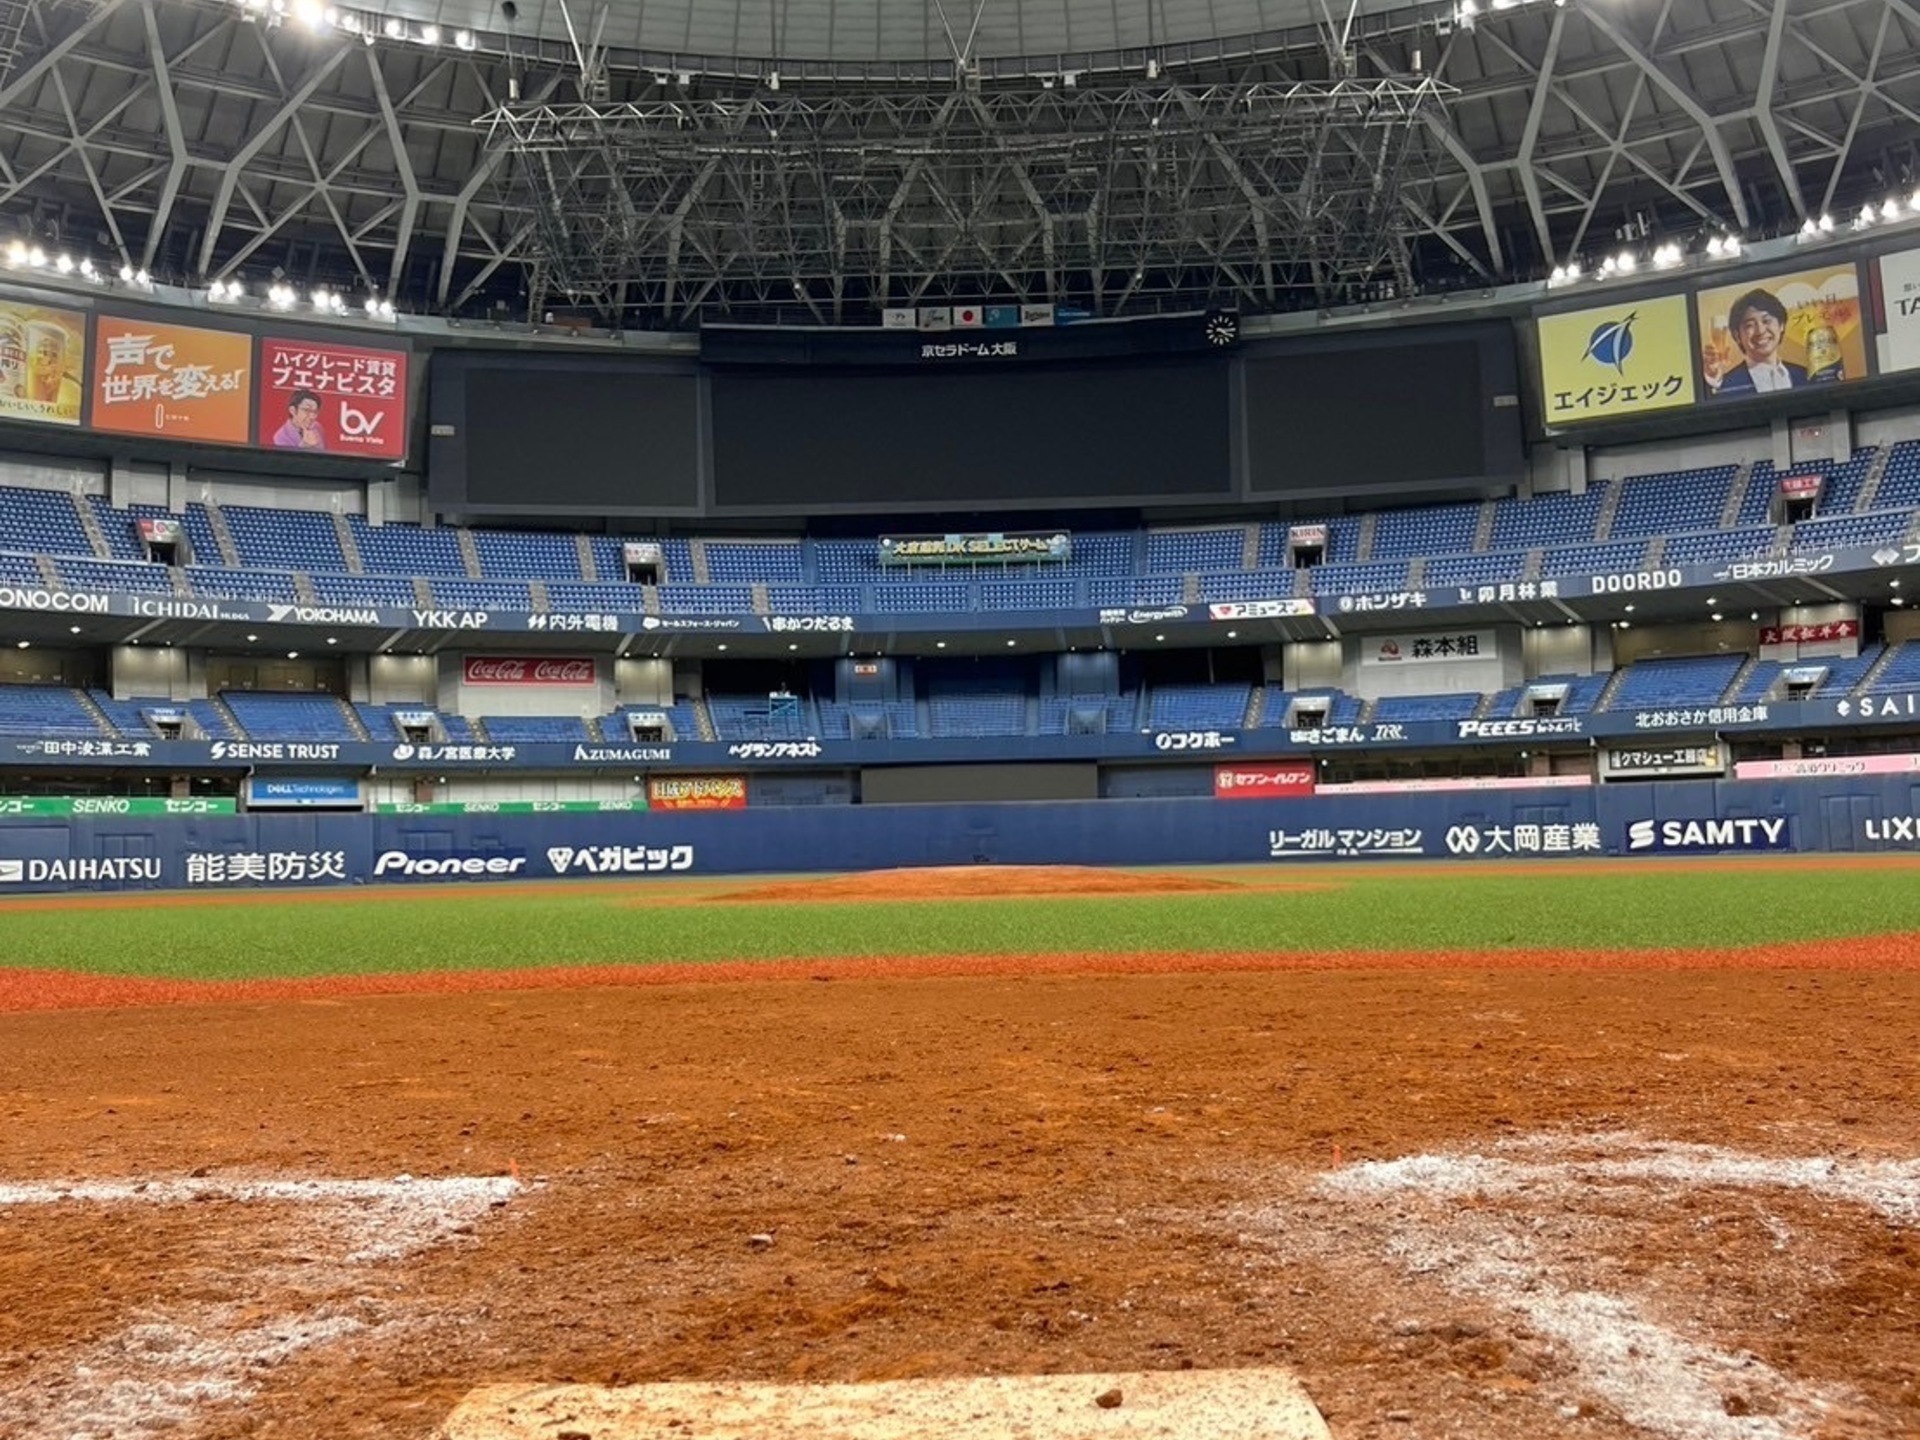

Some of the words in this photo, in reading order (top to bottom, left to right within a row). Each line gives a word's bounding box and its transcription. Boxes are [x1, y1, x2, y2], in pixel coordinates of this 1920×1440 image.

[105, 333, 175, 374] 声で
[921, 344, 989, 358] 京セラドーム
[273, 352, 397, 376] ハイグレード賃貸
[272, 366, 396, 396] ブエナビスタ
[1554, 375, 1683, 410] エイジェック
[1732, 554, 1834, 580] 日本カルミック
[1592, 569, 1682, 594] DOORDO
[294, 606, 380, 623] YOKOHAMA
[413, 610, 457, 629] YKK
[459, 611, 488, 629] AP
[550, 614, 618, 631] 内外電機
[772, 616, 854, 631] 串かつだるま
[1412, 634, 1480, 658] 森本組
[1635, 705, 1768, 728] 北おおさか信用金庫
[229, 744, 284, 759] SENSE
[288, 744, 339, 760] TRUST
[418, 746, 516, 761] 森ノ宮医療大学
[574, 744, 670, 760] AZUMAGUMI
[72, 799, 130, 813] SENKO
[166, 799, 218, 812] センコー
[463, 802, 499, 812] SENKO
[598, 800, 633, 811] SENKO
[1485, 822, 1601, 852] 大岡産業
[1662, 817, 1786, 846] SAMTY
[29, 857, 161, 881] DAIHATSU
[186, 850, 346, 882] 能美防災
[374, 850, 526, 875] Pioneer
